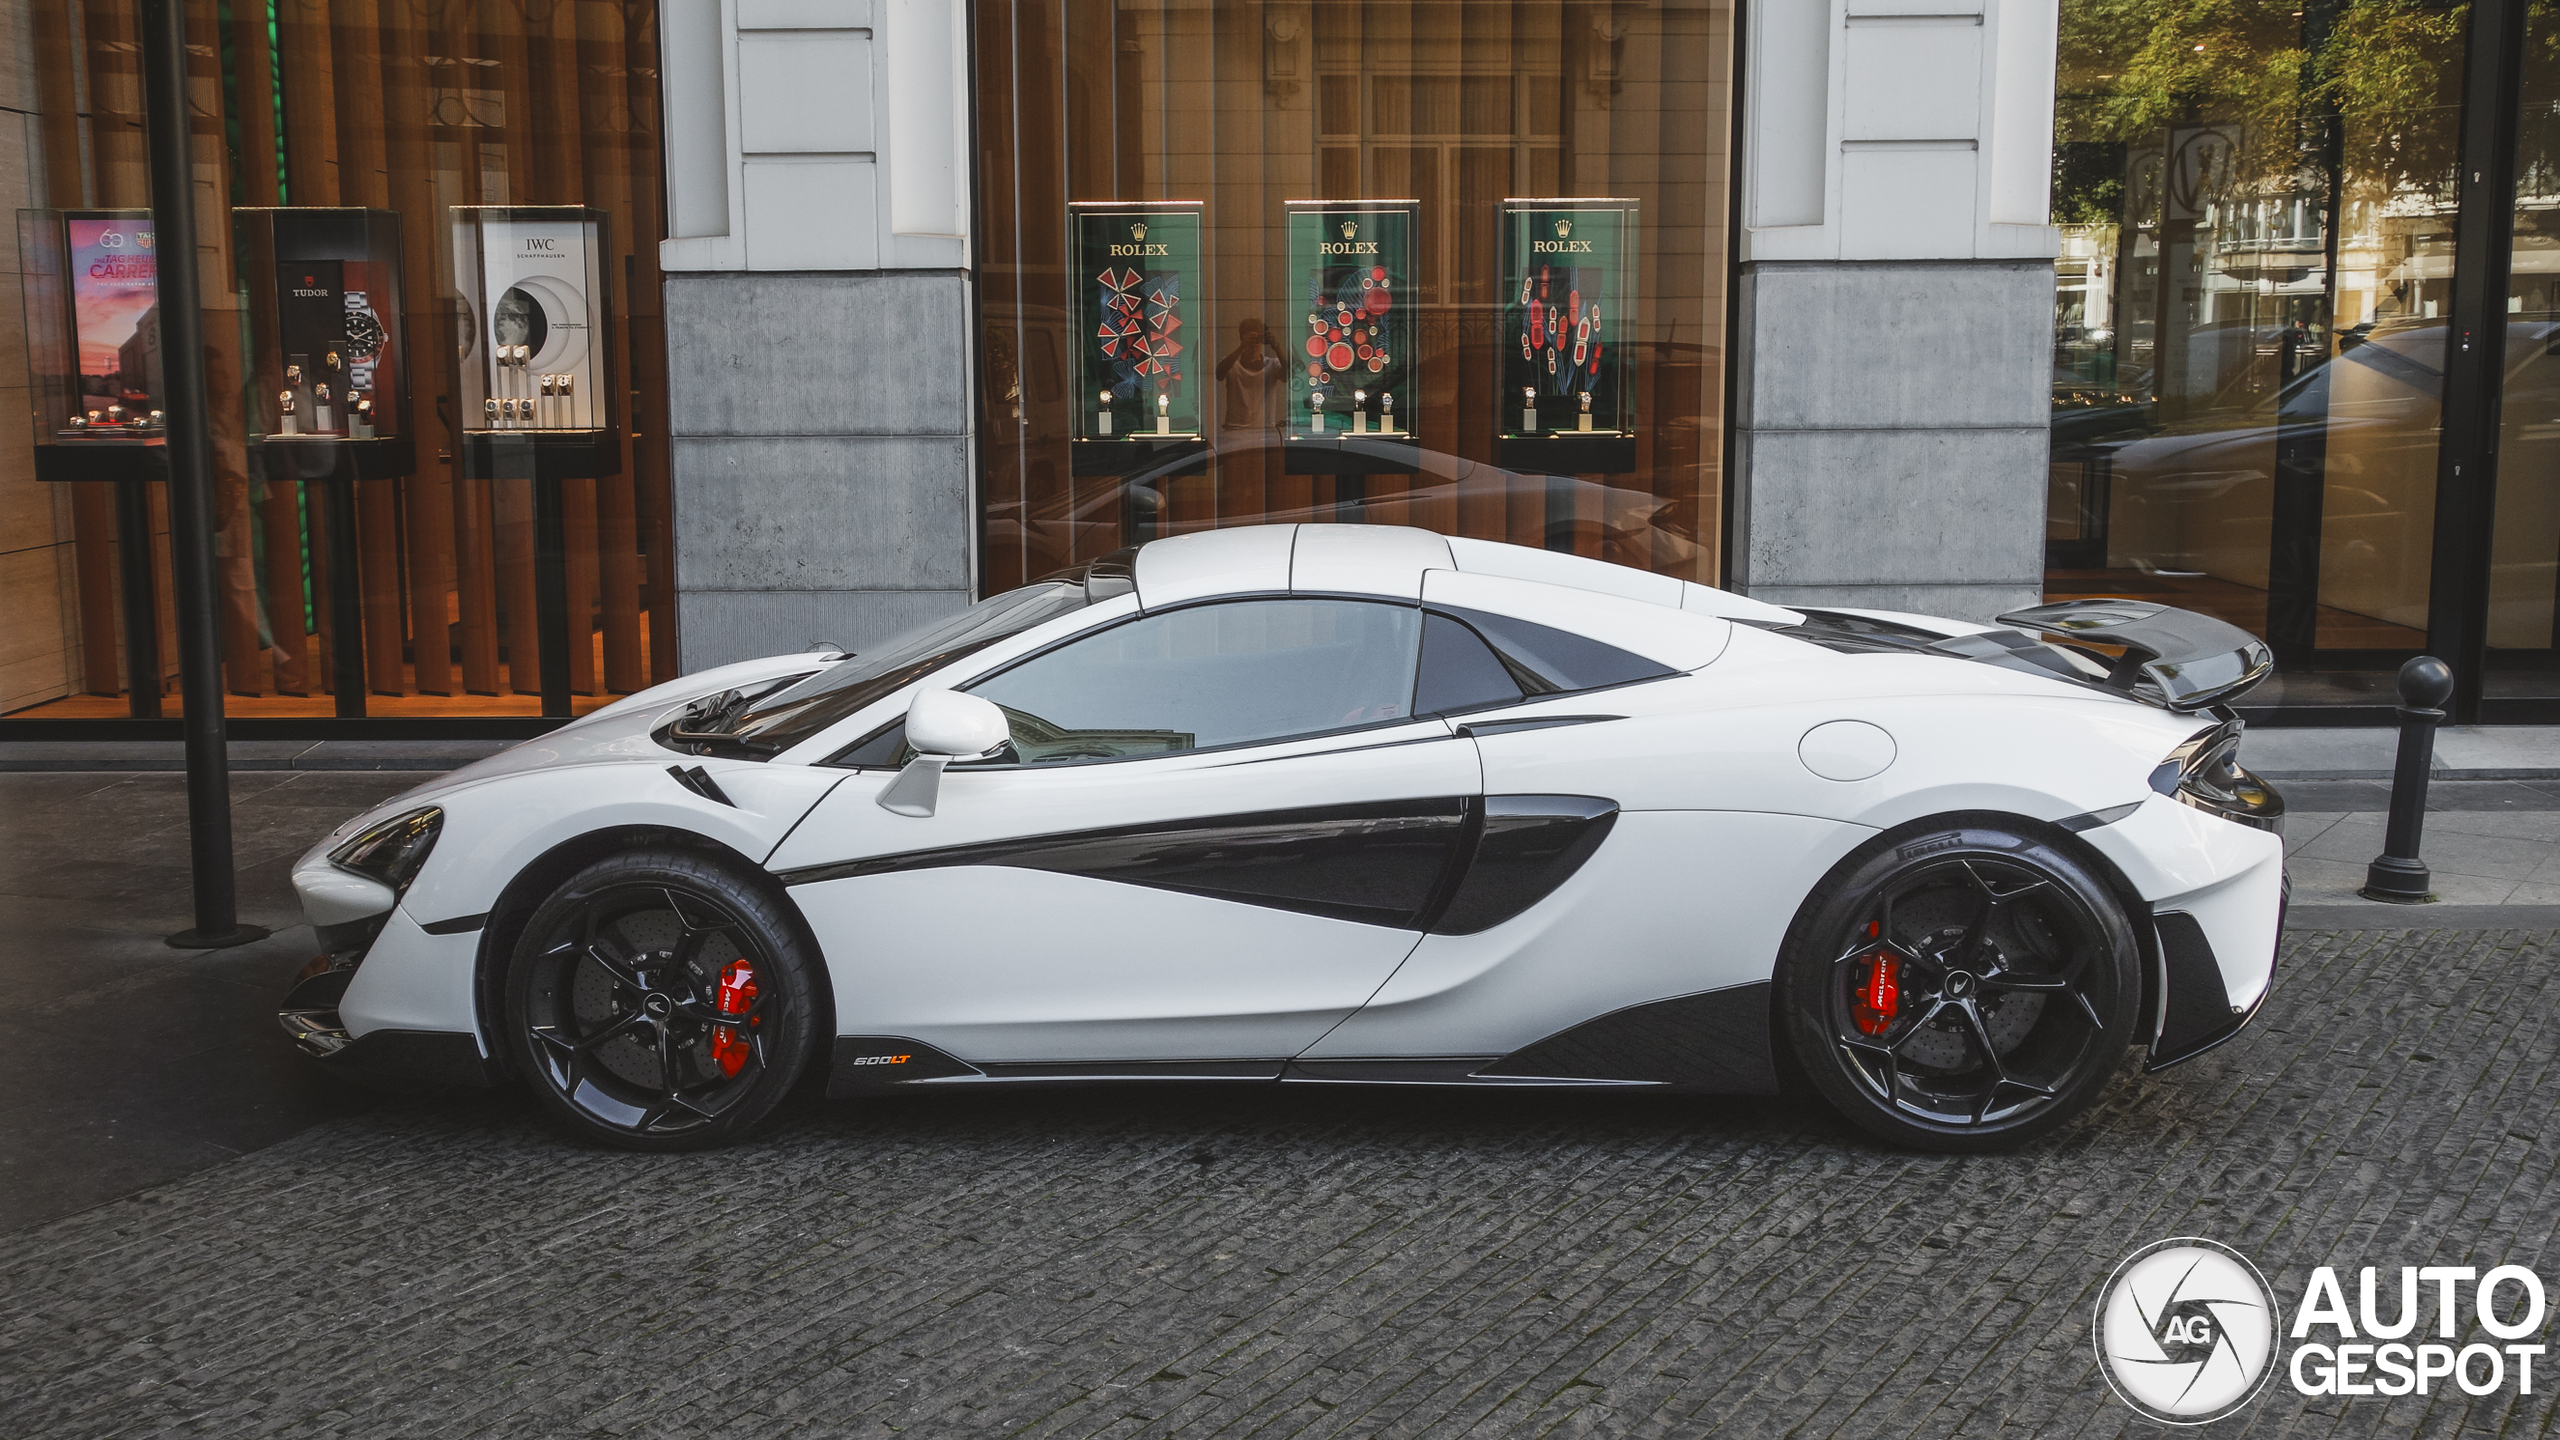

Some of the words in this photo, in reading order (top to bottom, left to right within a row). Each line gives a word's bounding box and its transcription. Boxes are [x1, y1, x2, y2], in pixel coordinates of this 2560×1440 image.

[526, 239, 555, 251] IWC
[1110, 244, 1169, 256] ROLEX
[1319, 242, 1379, 255] ROLEX
[1533, 240, 1593, 253] ROLEX
[105, 254, 125, 263] TAG
[293, 289, 328, 297] TUDOR
[1877, 959, 1887, 1007] McLaren
[853, 1054, 911, 1066] 600LT
